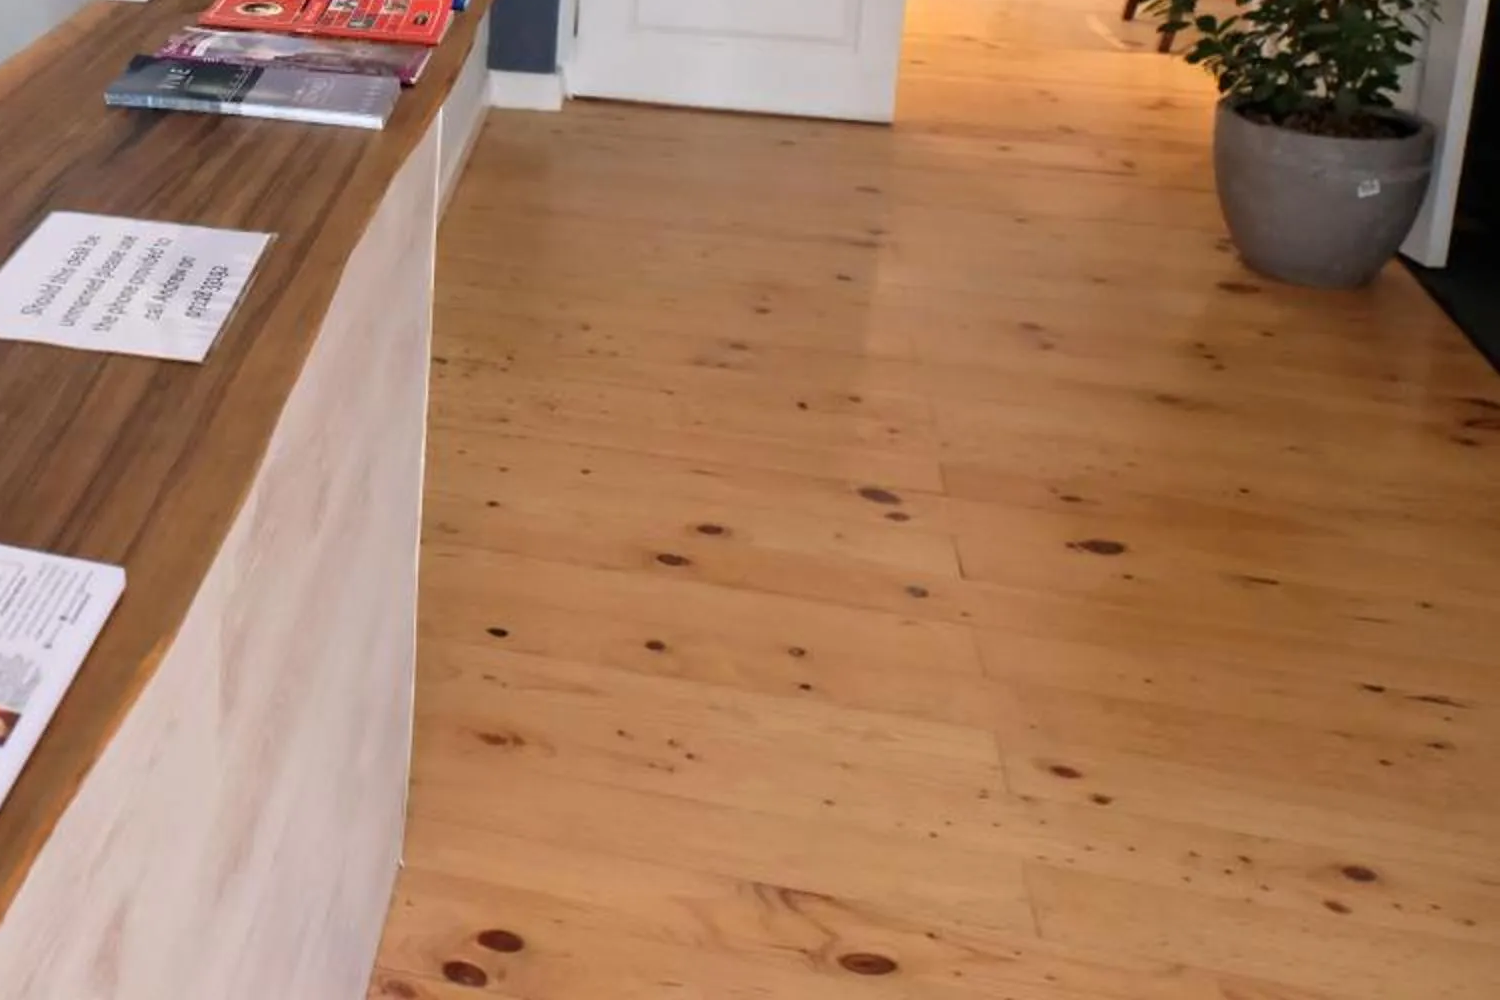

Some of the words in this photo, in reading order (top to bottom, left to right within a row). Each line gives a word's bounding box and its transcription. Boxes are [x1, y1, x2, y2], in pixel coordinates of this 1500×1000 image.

[153, 237, 174, 248] to
[20, 284, 62, 316] Should
[50, 266, 78, 285] this
[67, 247, 92, 266] desk
[80, 235, 101, 247] be
[128, 248, 165, 285] provided
[178, 255, 197, 269] on
[58, 278, 106, 327] unmanned
[94, 250, 128, 278] please
[119, 235, 140, 250] use
[151, 268, 188, 302] Andrew
[104, 285, 140, 315] phone
[144, 302, 167, 321] call
[92, 314, 120, 332] the
